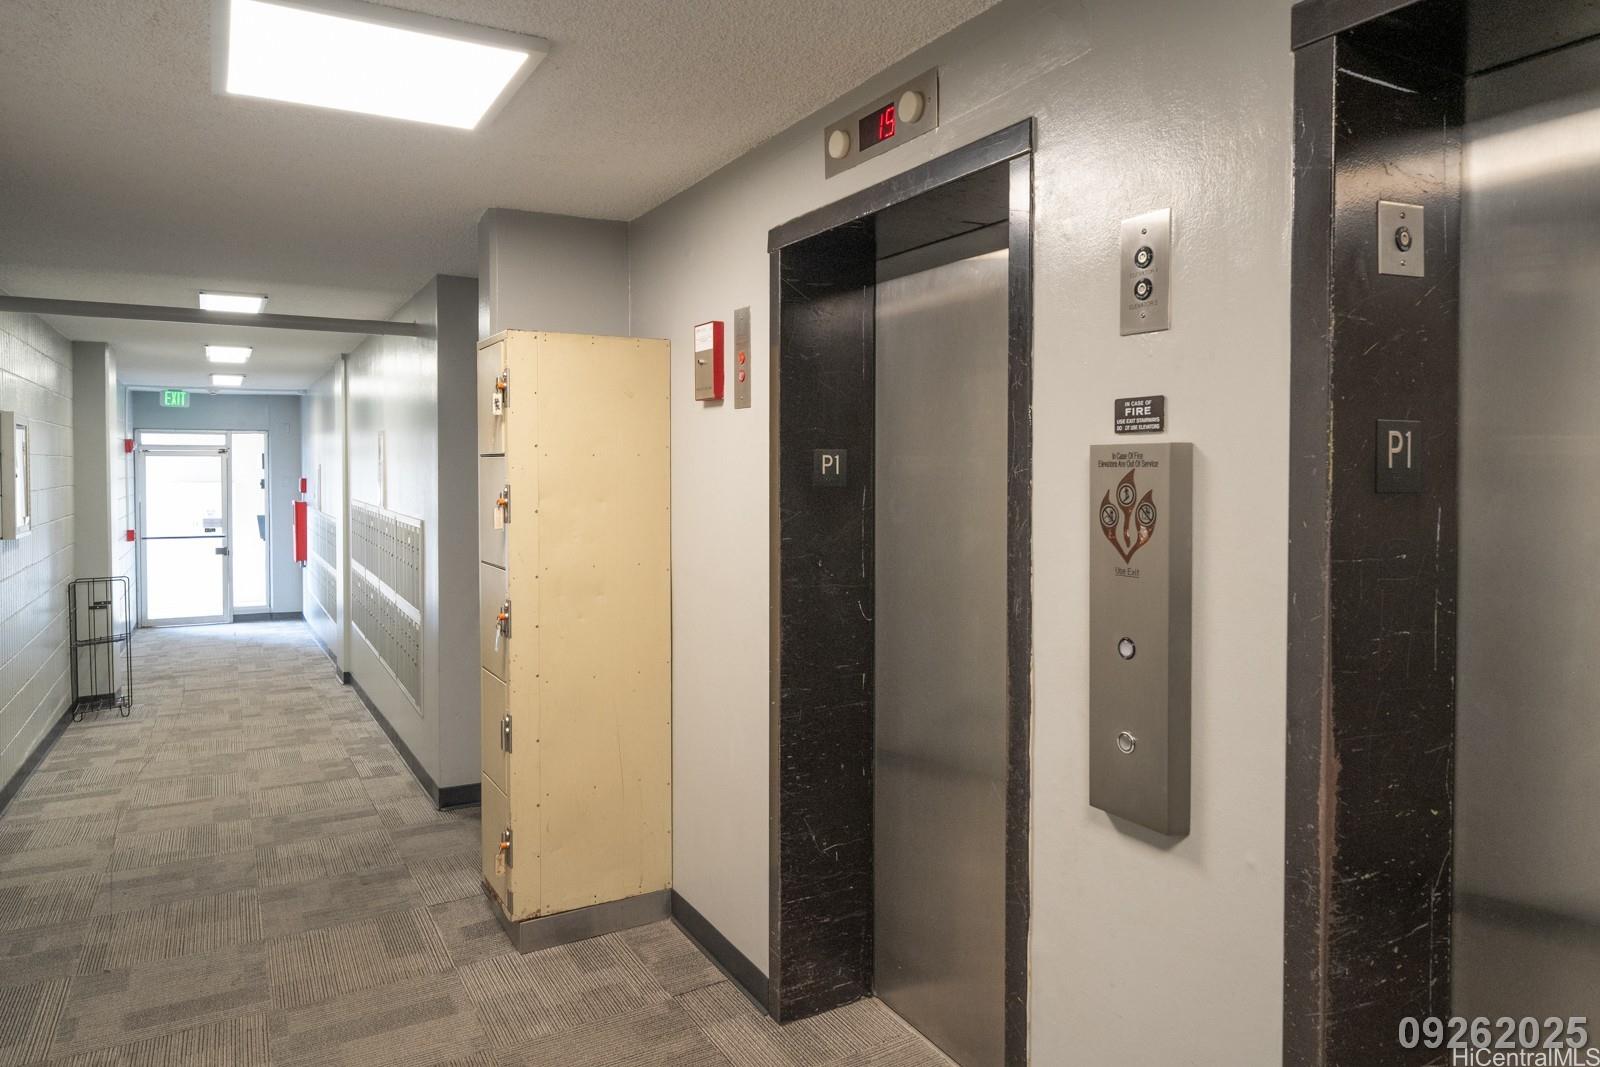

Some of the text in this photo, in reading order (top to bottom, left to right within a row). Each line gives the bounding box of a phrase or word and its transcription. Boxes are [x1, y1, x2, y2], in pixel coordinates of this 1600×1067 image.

[879, 105, 896, 140] 15
[164, 391, 187, 406] EXIT
[1125, 406, 1152, 417] FIRE
[1134, 451, 1143, 460] Fire
[1388, 430, 1412, 469] P1
[822, 454, 840, 475] P1
